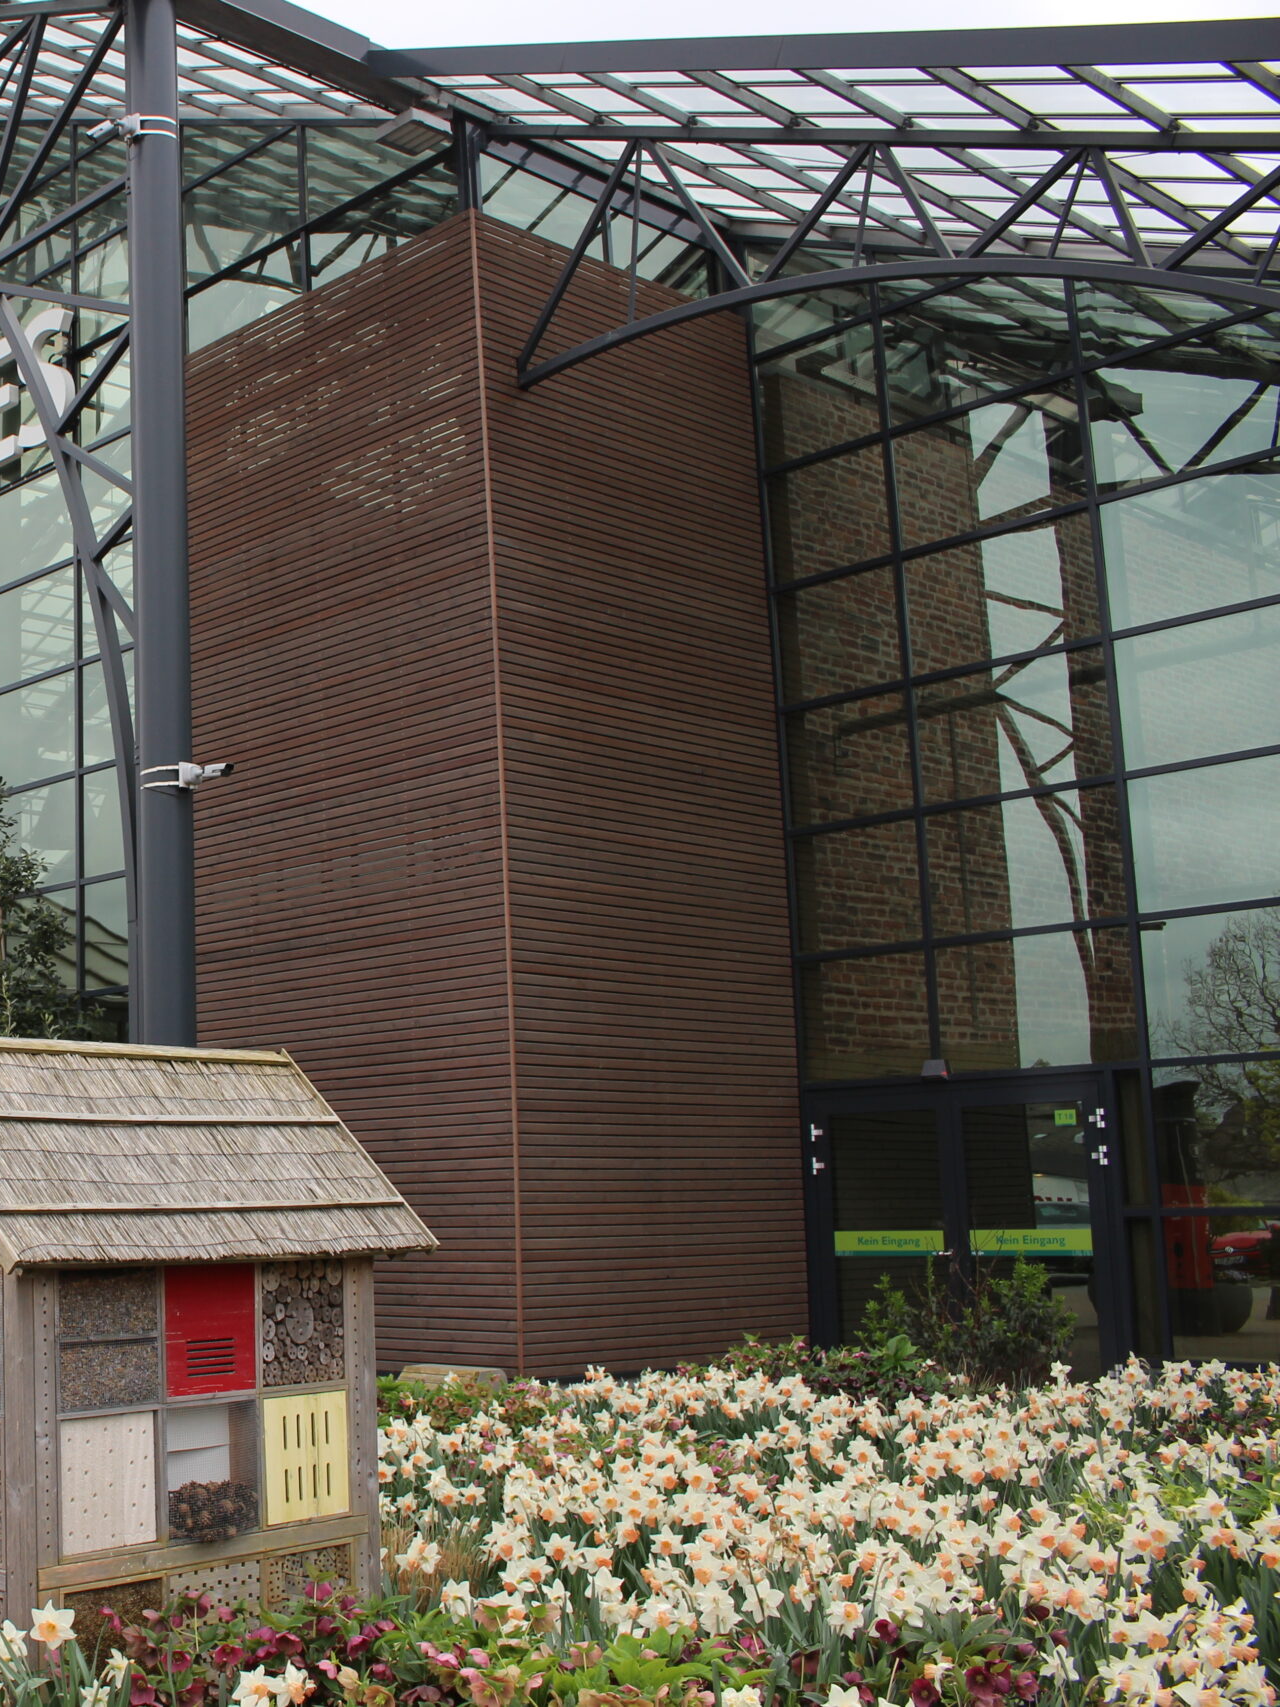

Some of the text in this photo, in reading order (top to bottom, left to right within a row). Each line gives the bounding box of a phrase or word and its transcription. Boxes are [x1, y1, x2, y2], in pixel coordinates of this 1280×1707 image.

[857, 1236, 920, 1248] Kein Eingang
[996, 1235, 1066, 1247] Kein Eingang
